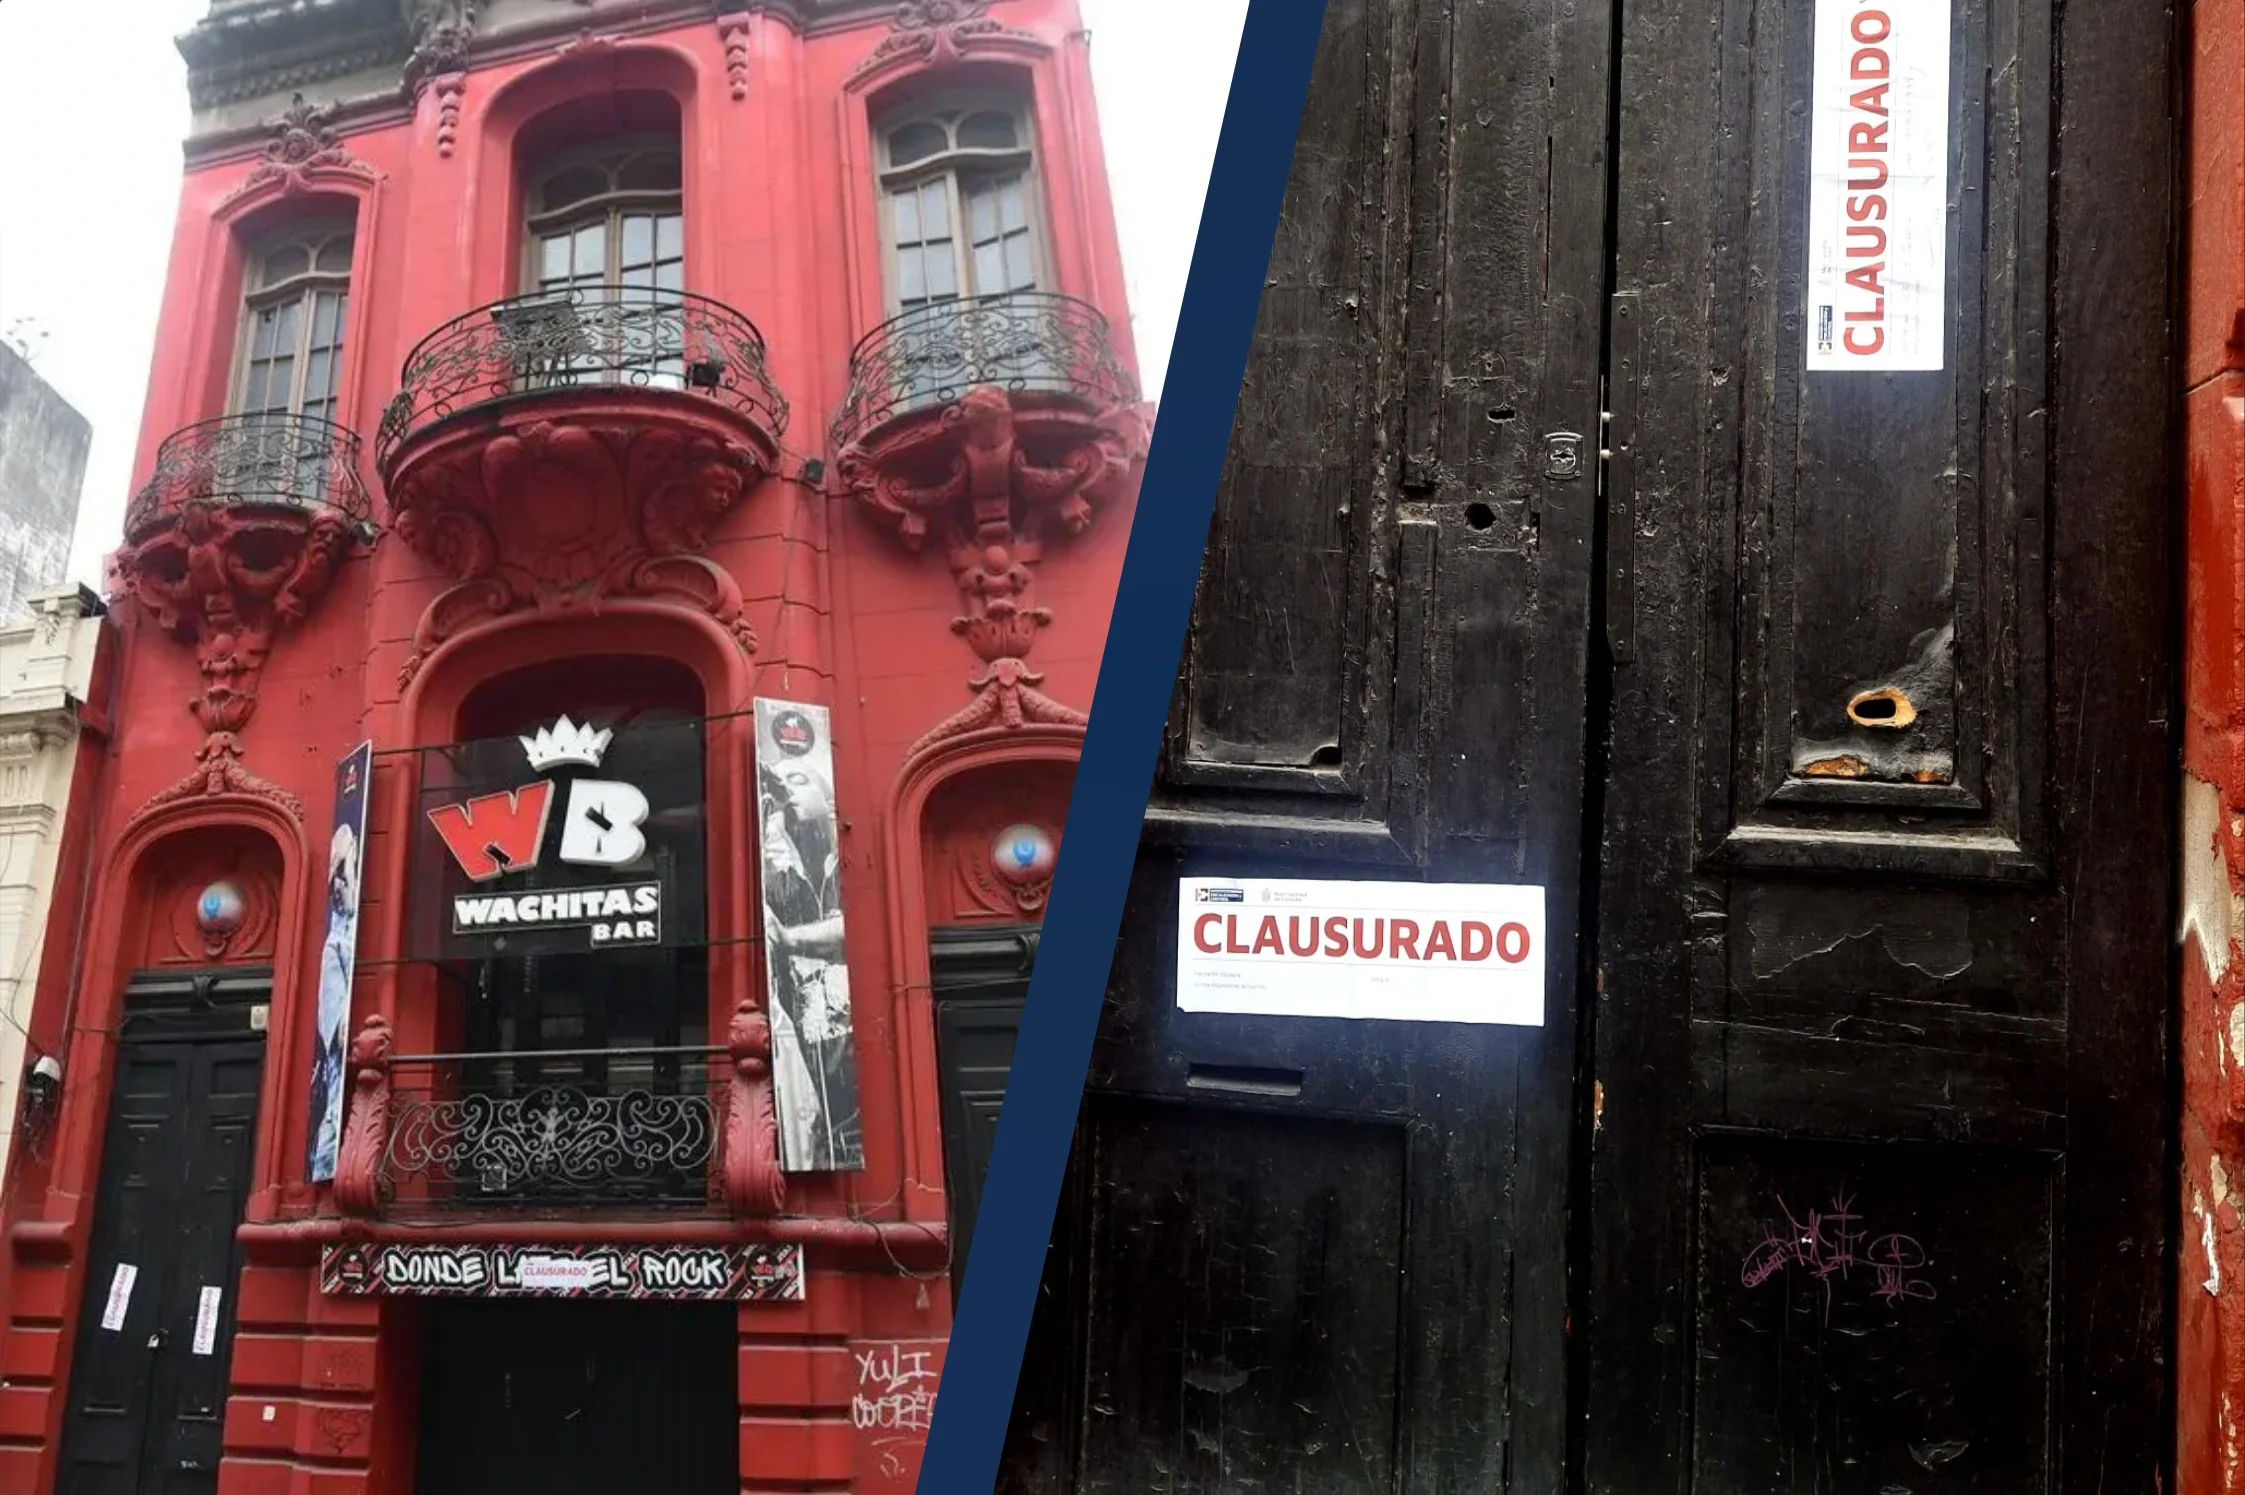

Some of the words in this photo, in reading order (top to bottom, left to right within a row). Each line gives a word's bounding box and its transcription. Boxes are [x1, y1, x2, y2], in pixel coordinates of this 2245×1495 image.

[1843, 9, 1891, 356] CLAUSURADO
[454, 886, 658, 925] WACHITAS
[592, 920, 656, 941] BAR
[1194, 912, 1531, 963] CLAUSURADO
[387, 1253, 485, 1284] DONDE
[642, 1256, 725, 1286] ROCK
[524, 1266, 588, 1277] CLAUSURADO
